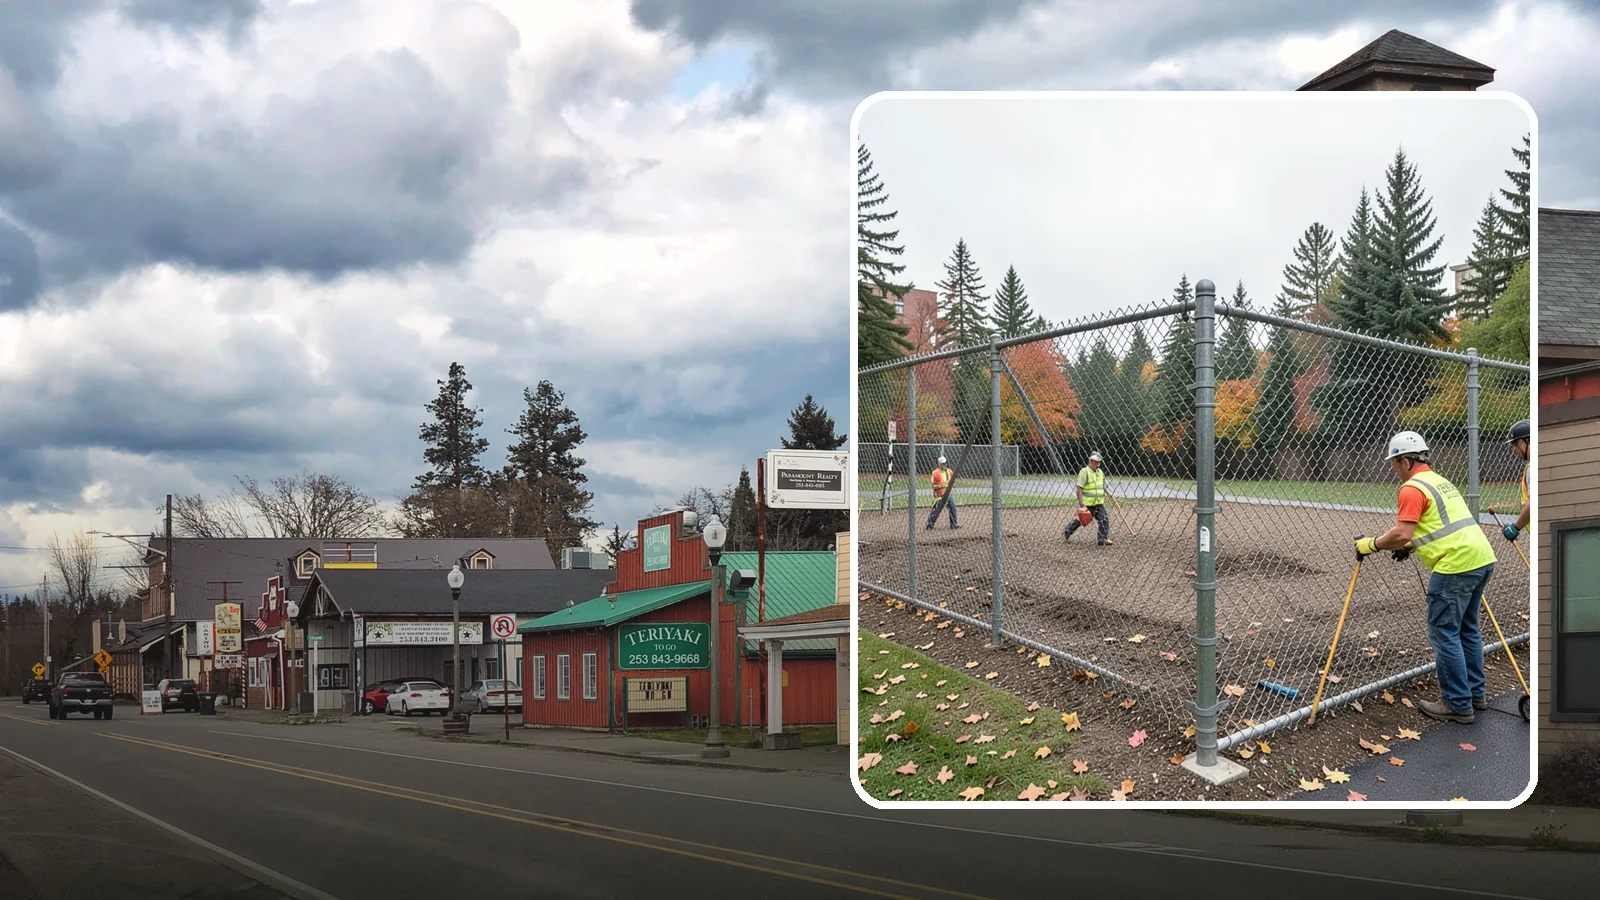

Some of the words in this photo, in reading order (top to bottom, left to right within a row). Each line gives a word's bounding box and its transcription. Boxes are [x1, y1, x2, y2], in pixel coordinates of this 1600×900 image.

[781, 471, 815, 479] PARAMOUNT
[817, 472, 839, 480] REALTY
[229, 606, 240, 615] Roy
[624, 627, 703, 646] TERIYAKI
[653, 643, 665, 651] TO
[665, 643, 677, 651] GO
[628, 654, 649, 665] 253
[651, 653, 700, 664] 843-9668
[639, 681, 672, 691] TERIYAKI
